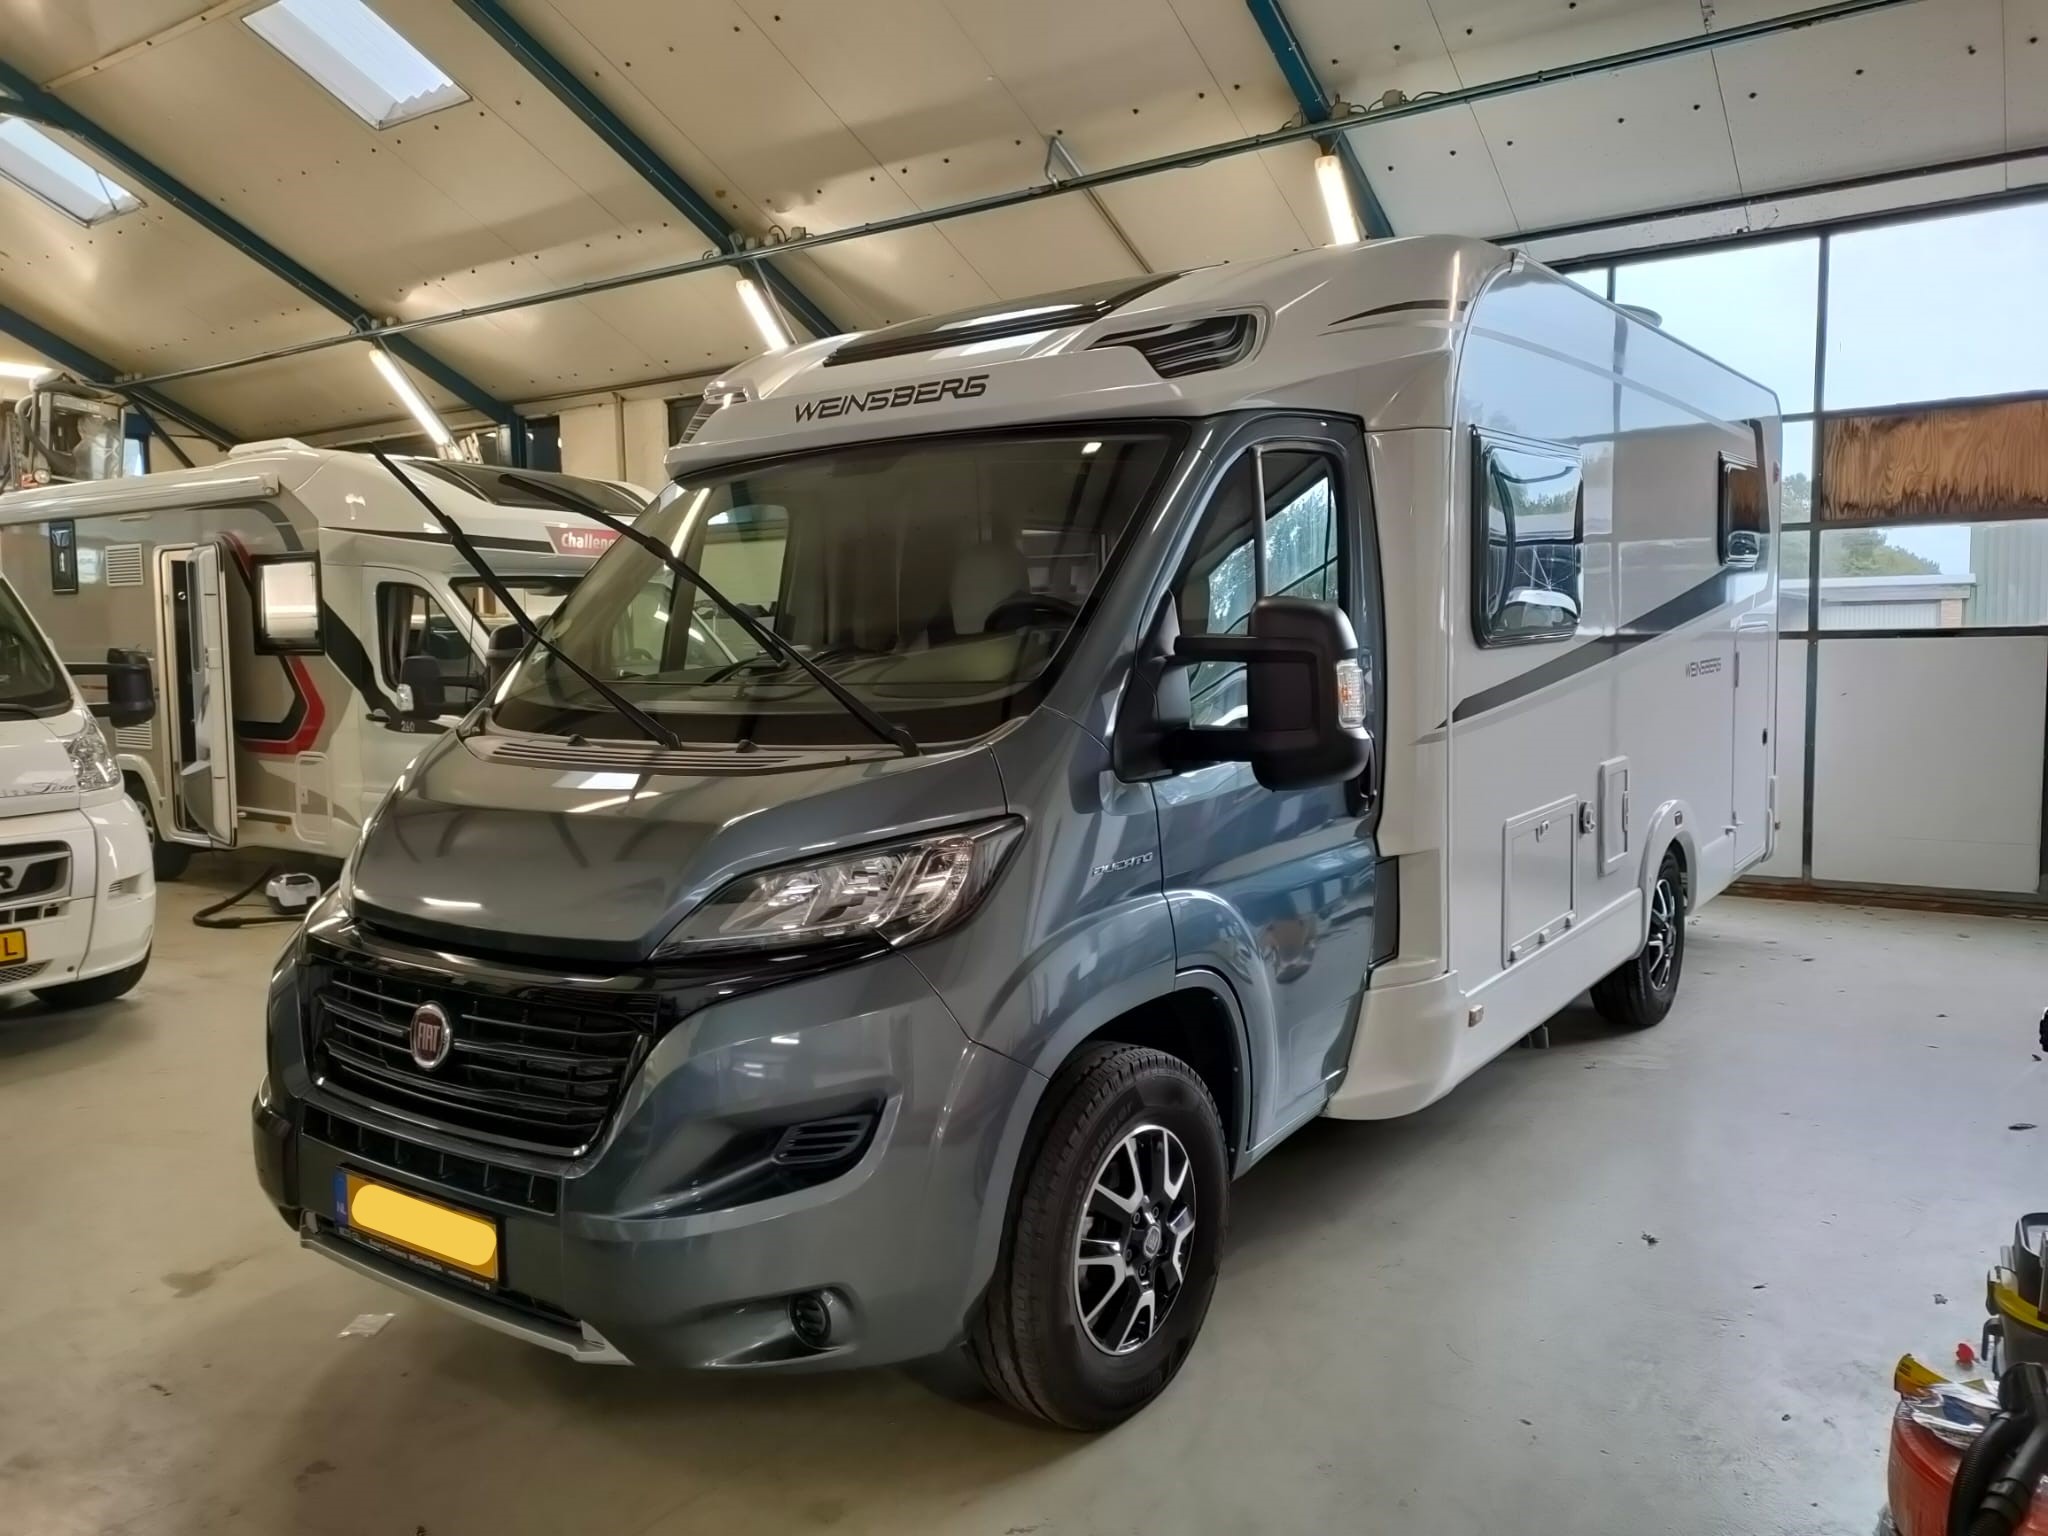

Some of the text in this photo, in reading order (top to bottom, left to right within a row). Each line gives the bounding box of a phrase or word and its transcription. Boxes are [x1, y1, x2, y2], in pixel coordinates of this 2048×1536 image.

[795, 374, 990, 423] WEINSBERG
[418, 1022, 440, 1052] FIAT
[336, 1201, 347, 1215] NL
